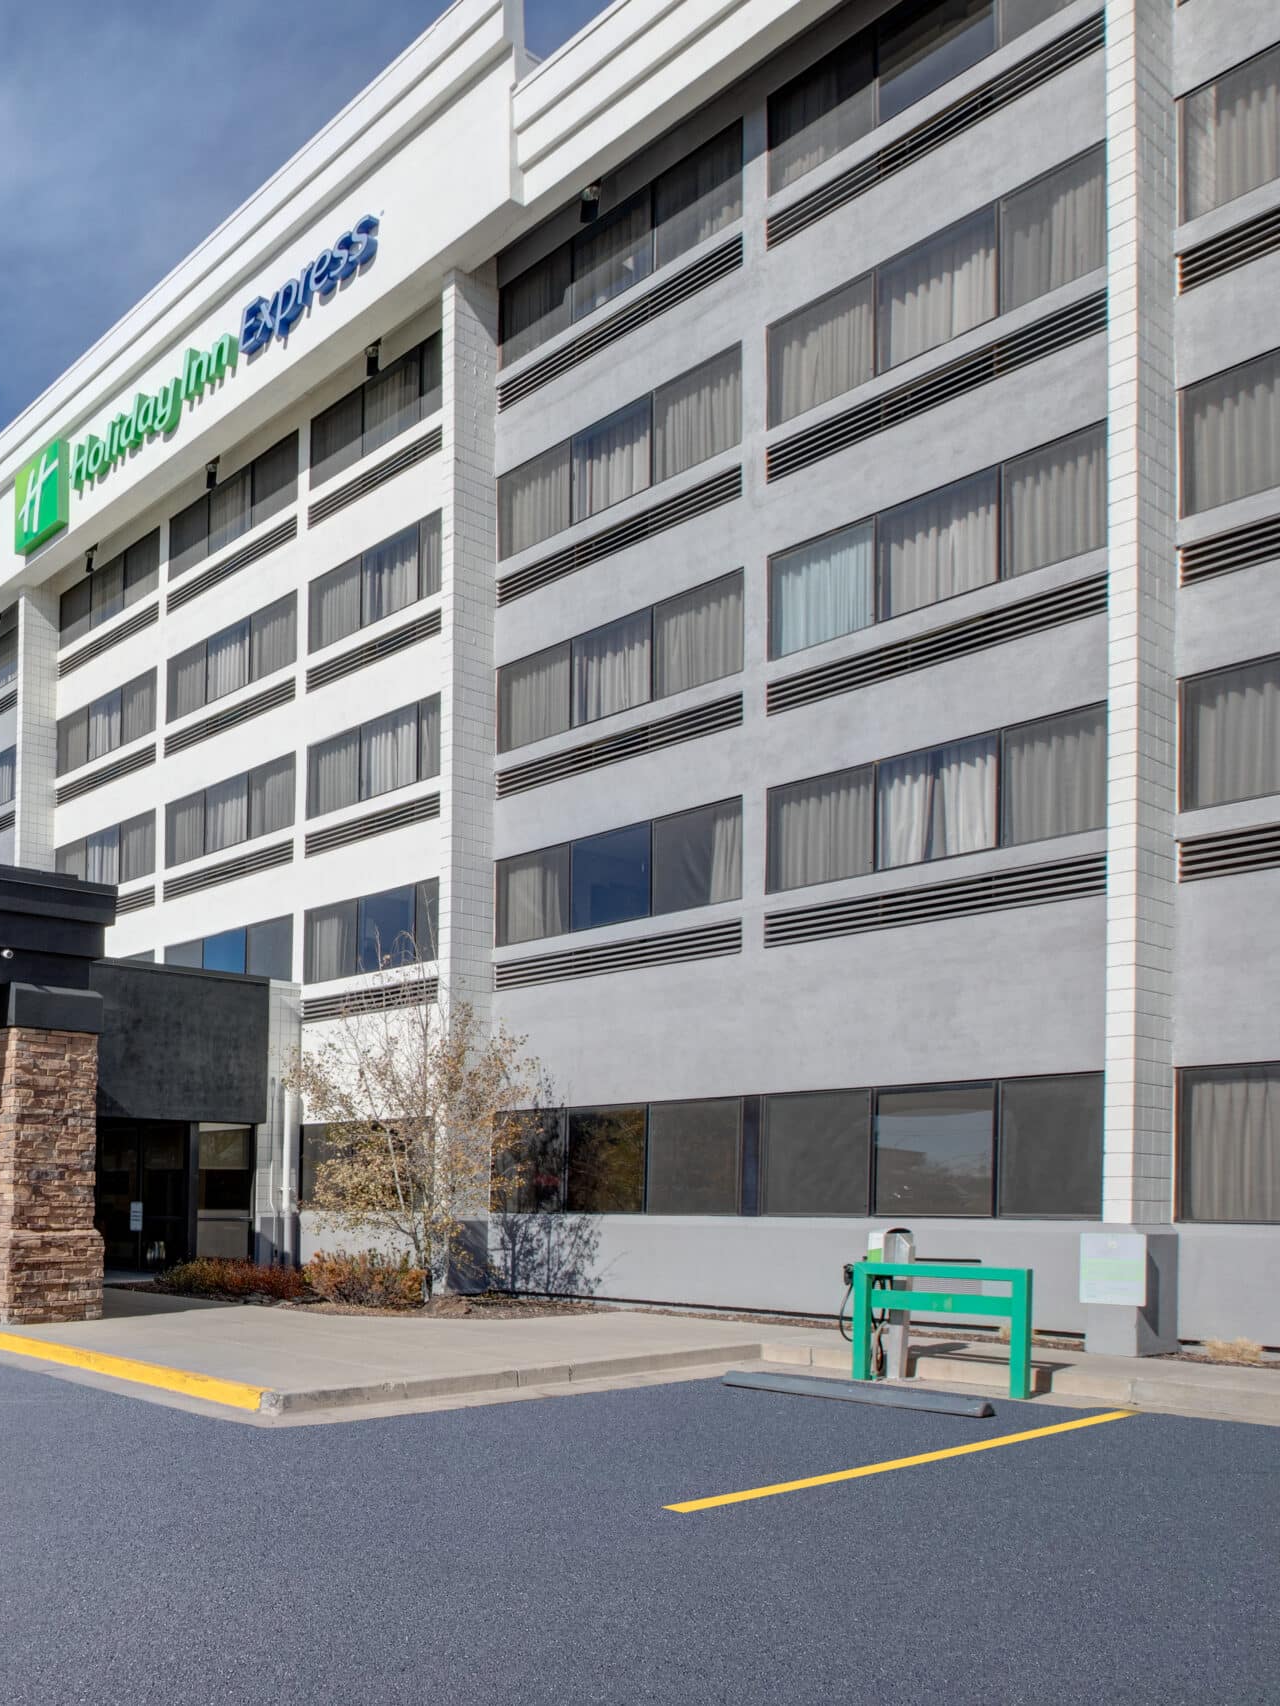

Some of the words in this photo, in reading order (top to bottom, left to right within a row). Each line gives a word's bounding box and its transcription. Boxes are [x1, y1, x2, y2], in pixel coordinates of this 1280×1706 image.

[71, 377, 183, 492] Holiday
[181, 333, 239, 402] Inn
[238, 214, 380, 355] Express
